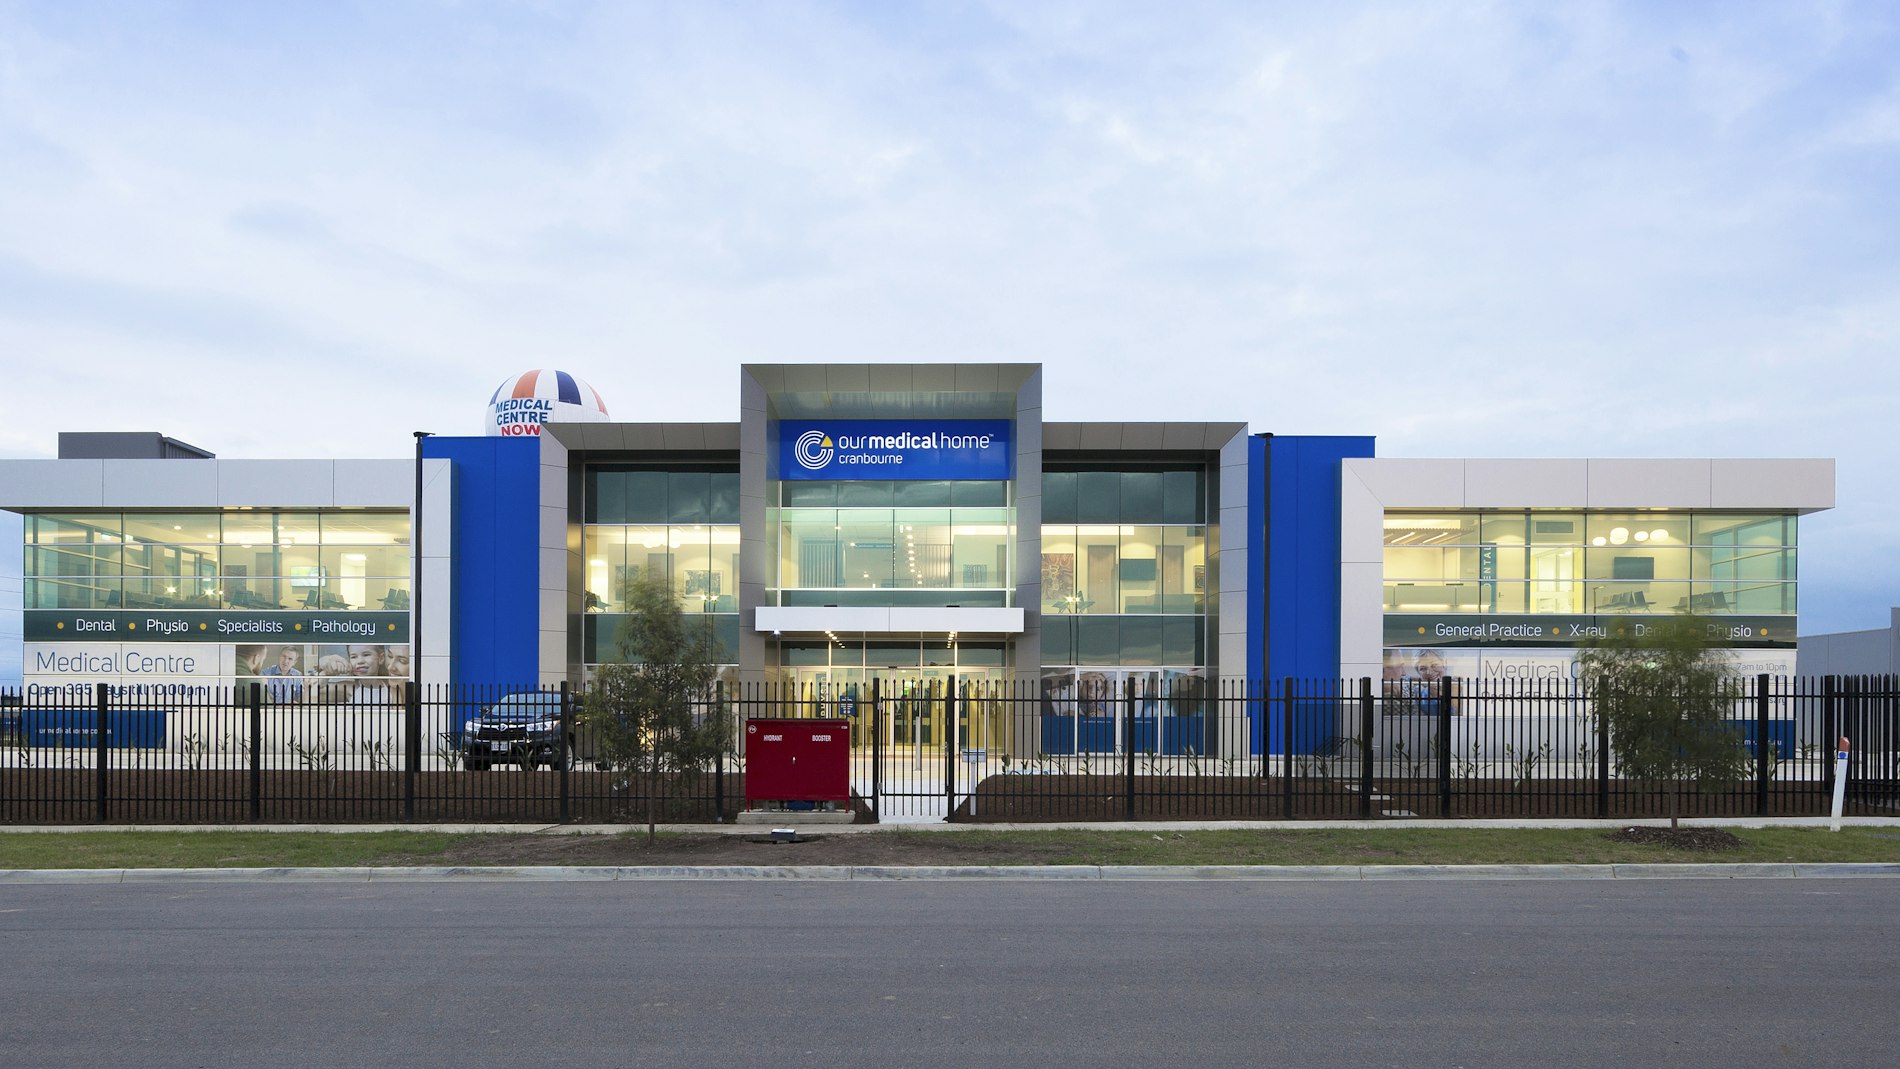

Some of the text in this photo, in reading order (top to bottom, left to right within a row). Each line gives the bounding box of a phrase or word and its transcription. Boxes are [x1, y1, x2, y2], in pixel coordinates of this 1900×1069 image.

[495, 399, 553, 413] MEDICAL
[497, 411, 548, 425] CENTRE
[501, 424, 540, 436] NOW
[838, 452, 903, 464] cranbourne
[76, 618, 376, 636] Dental Physio Specialists Pathology
[1435, 623, 1487, 638] General
[1489, 623, 1543, 638] Practice
[1569, 623, 1607, 639] X-ray
[1706, 623, 1752, 640] Physio
[36, 651, 195, 673] Medical Centre
[1737, 663, 1755, 671] 7am
[1756, 663, 1764, 671] to
[1766, 663, 1788, 672] 10pm
[1485, 659, 1568, 680] Medical
[99, 684, 128, 699] ays
[811, 734, 832, 742] BOOSTER
